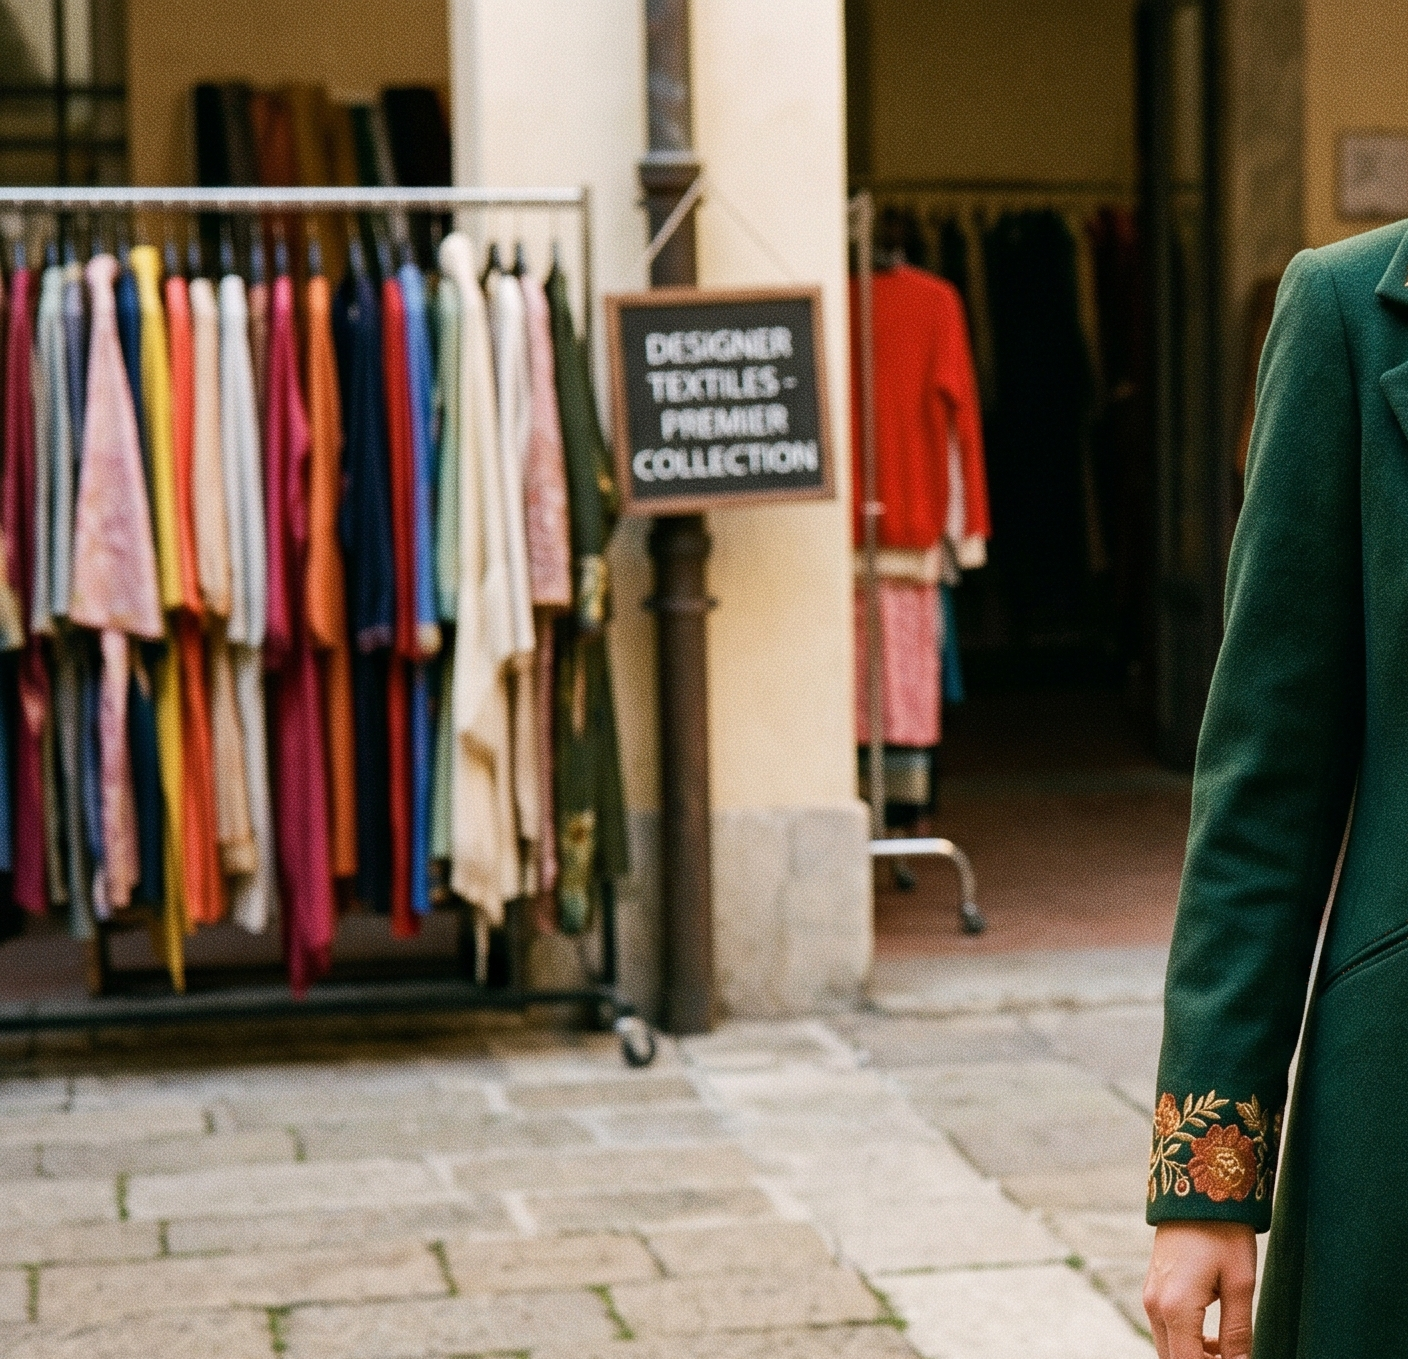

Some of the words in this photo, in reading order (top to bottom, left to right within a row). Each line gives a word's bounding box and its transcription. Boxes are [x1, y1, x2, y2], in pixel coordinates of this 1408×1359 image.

[645, 327, 793, 365] DESIGNER
[646, 366, 781, 403] TEXTILES
[661, 404, 789, 441] PREMIER
[633, 441, 818, 482] COLLECTION
